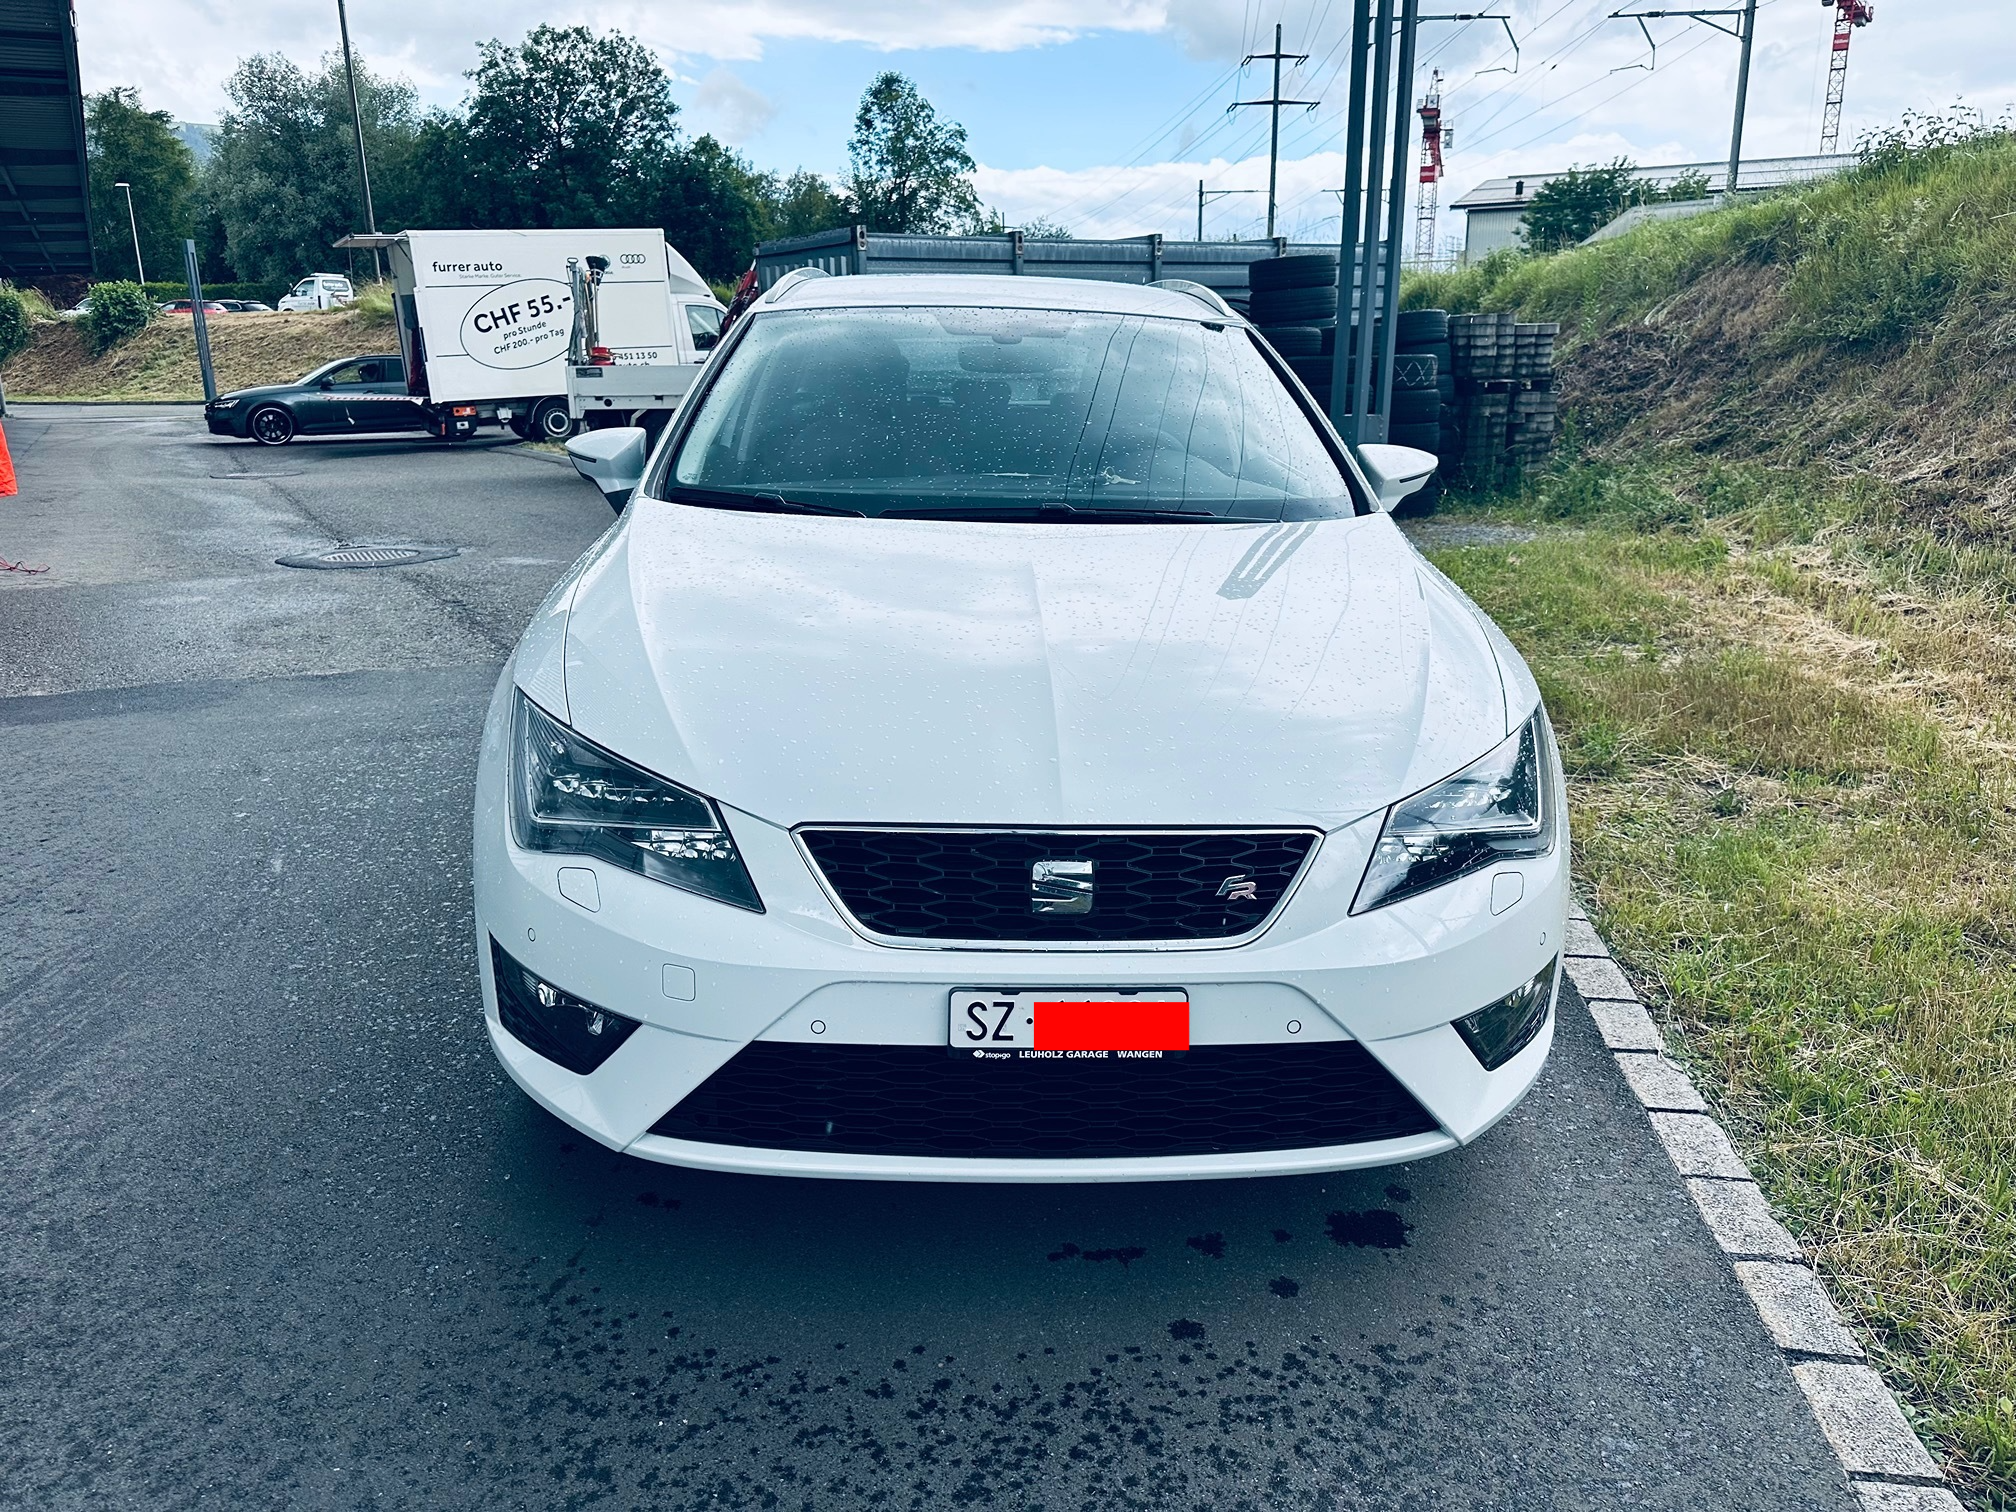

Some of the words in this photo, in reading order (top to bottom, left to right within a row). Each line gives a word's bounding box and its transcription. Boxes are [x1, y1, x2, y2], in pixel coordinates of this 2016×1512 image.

[432, 261, 471, 272] furrer
[473, 261, 503, 271] auto
[474, 302, 521, 333] CHF
[526, 294, 571, 318] 55.-
[493, 343, 511, 354] CHF
[513, 338, 533, 349] 200.-
[535, 333, 549, 344] pro
[549, 328, 565, 337] Tag
[503, 330, 517, 341] pro
[518, 321, 547, 335] Stunde
[647, 351, 658, 359] 50
[1215, 874, 1257, 900] FR
[1019, 1050, 1064, 1059] LEUHOLZ
[1066, 1050, 1109, 1059] GARAGE
[1117, 1050, 1163, 1058] WANGEN
